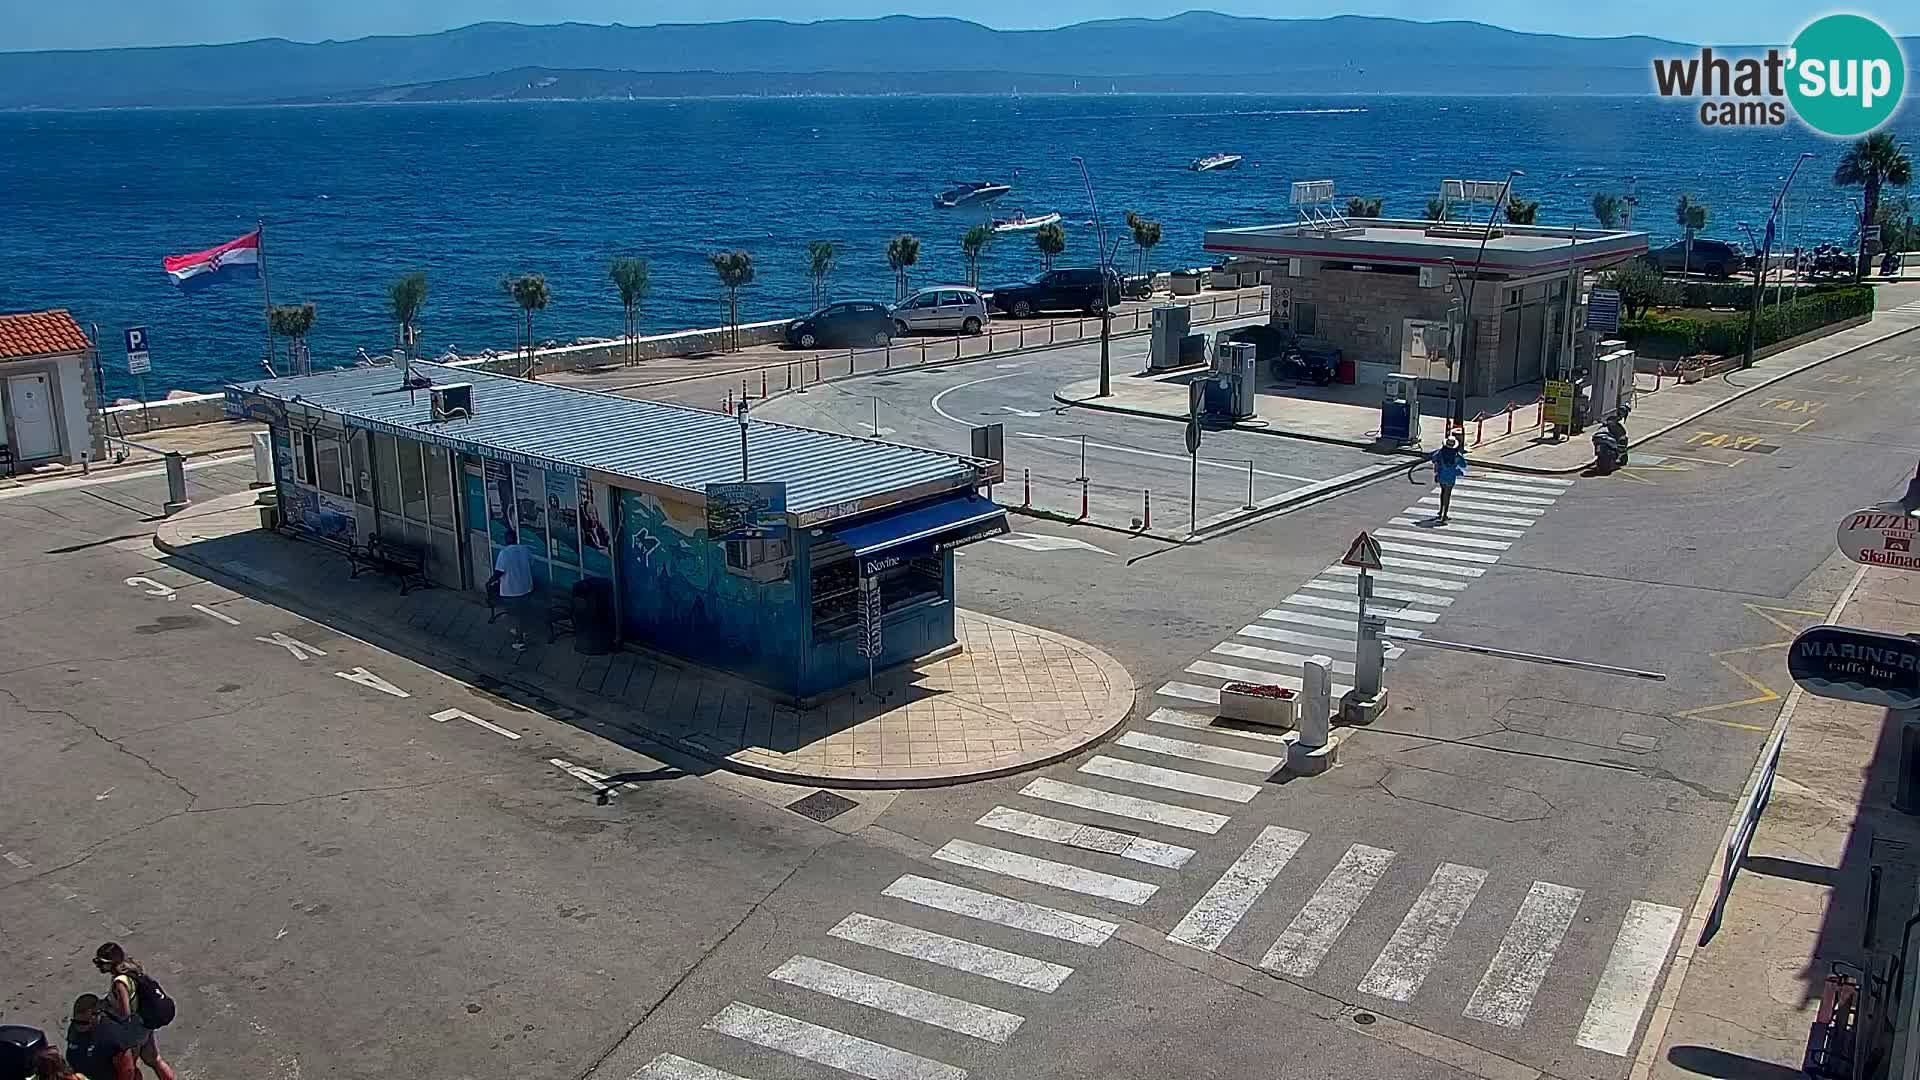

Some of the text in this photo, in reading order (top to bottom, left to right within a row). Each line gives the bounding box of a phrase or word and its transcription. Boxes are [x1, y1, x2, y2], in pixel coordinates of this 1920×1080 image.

[130, 331, 142, 349] P
[1686, 431, 1764, 451] TAXI
[478, 446, 492, 457] BUS
[494, 450, 526, 465] STATION
[528, 457, 554, 470] TICKET
[555, 462, 582, 477] OFFICE
[1848, 514, 1920, 531] PIZZE
[1870, 665, 1897, 680] bar
